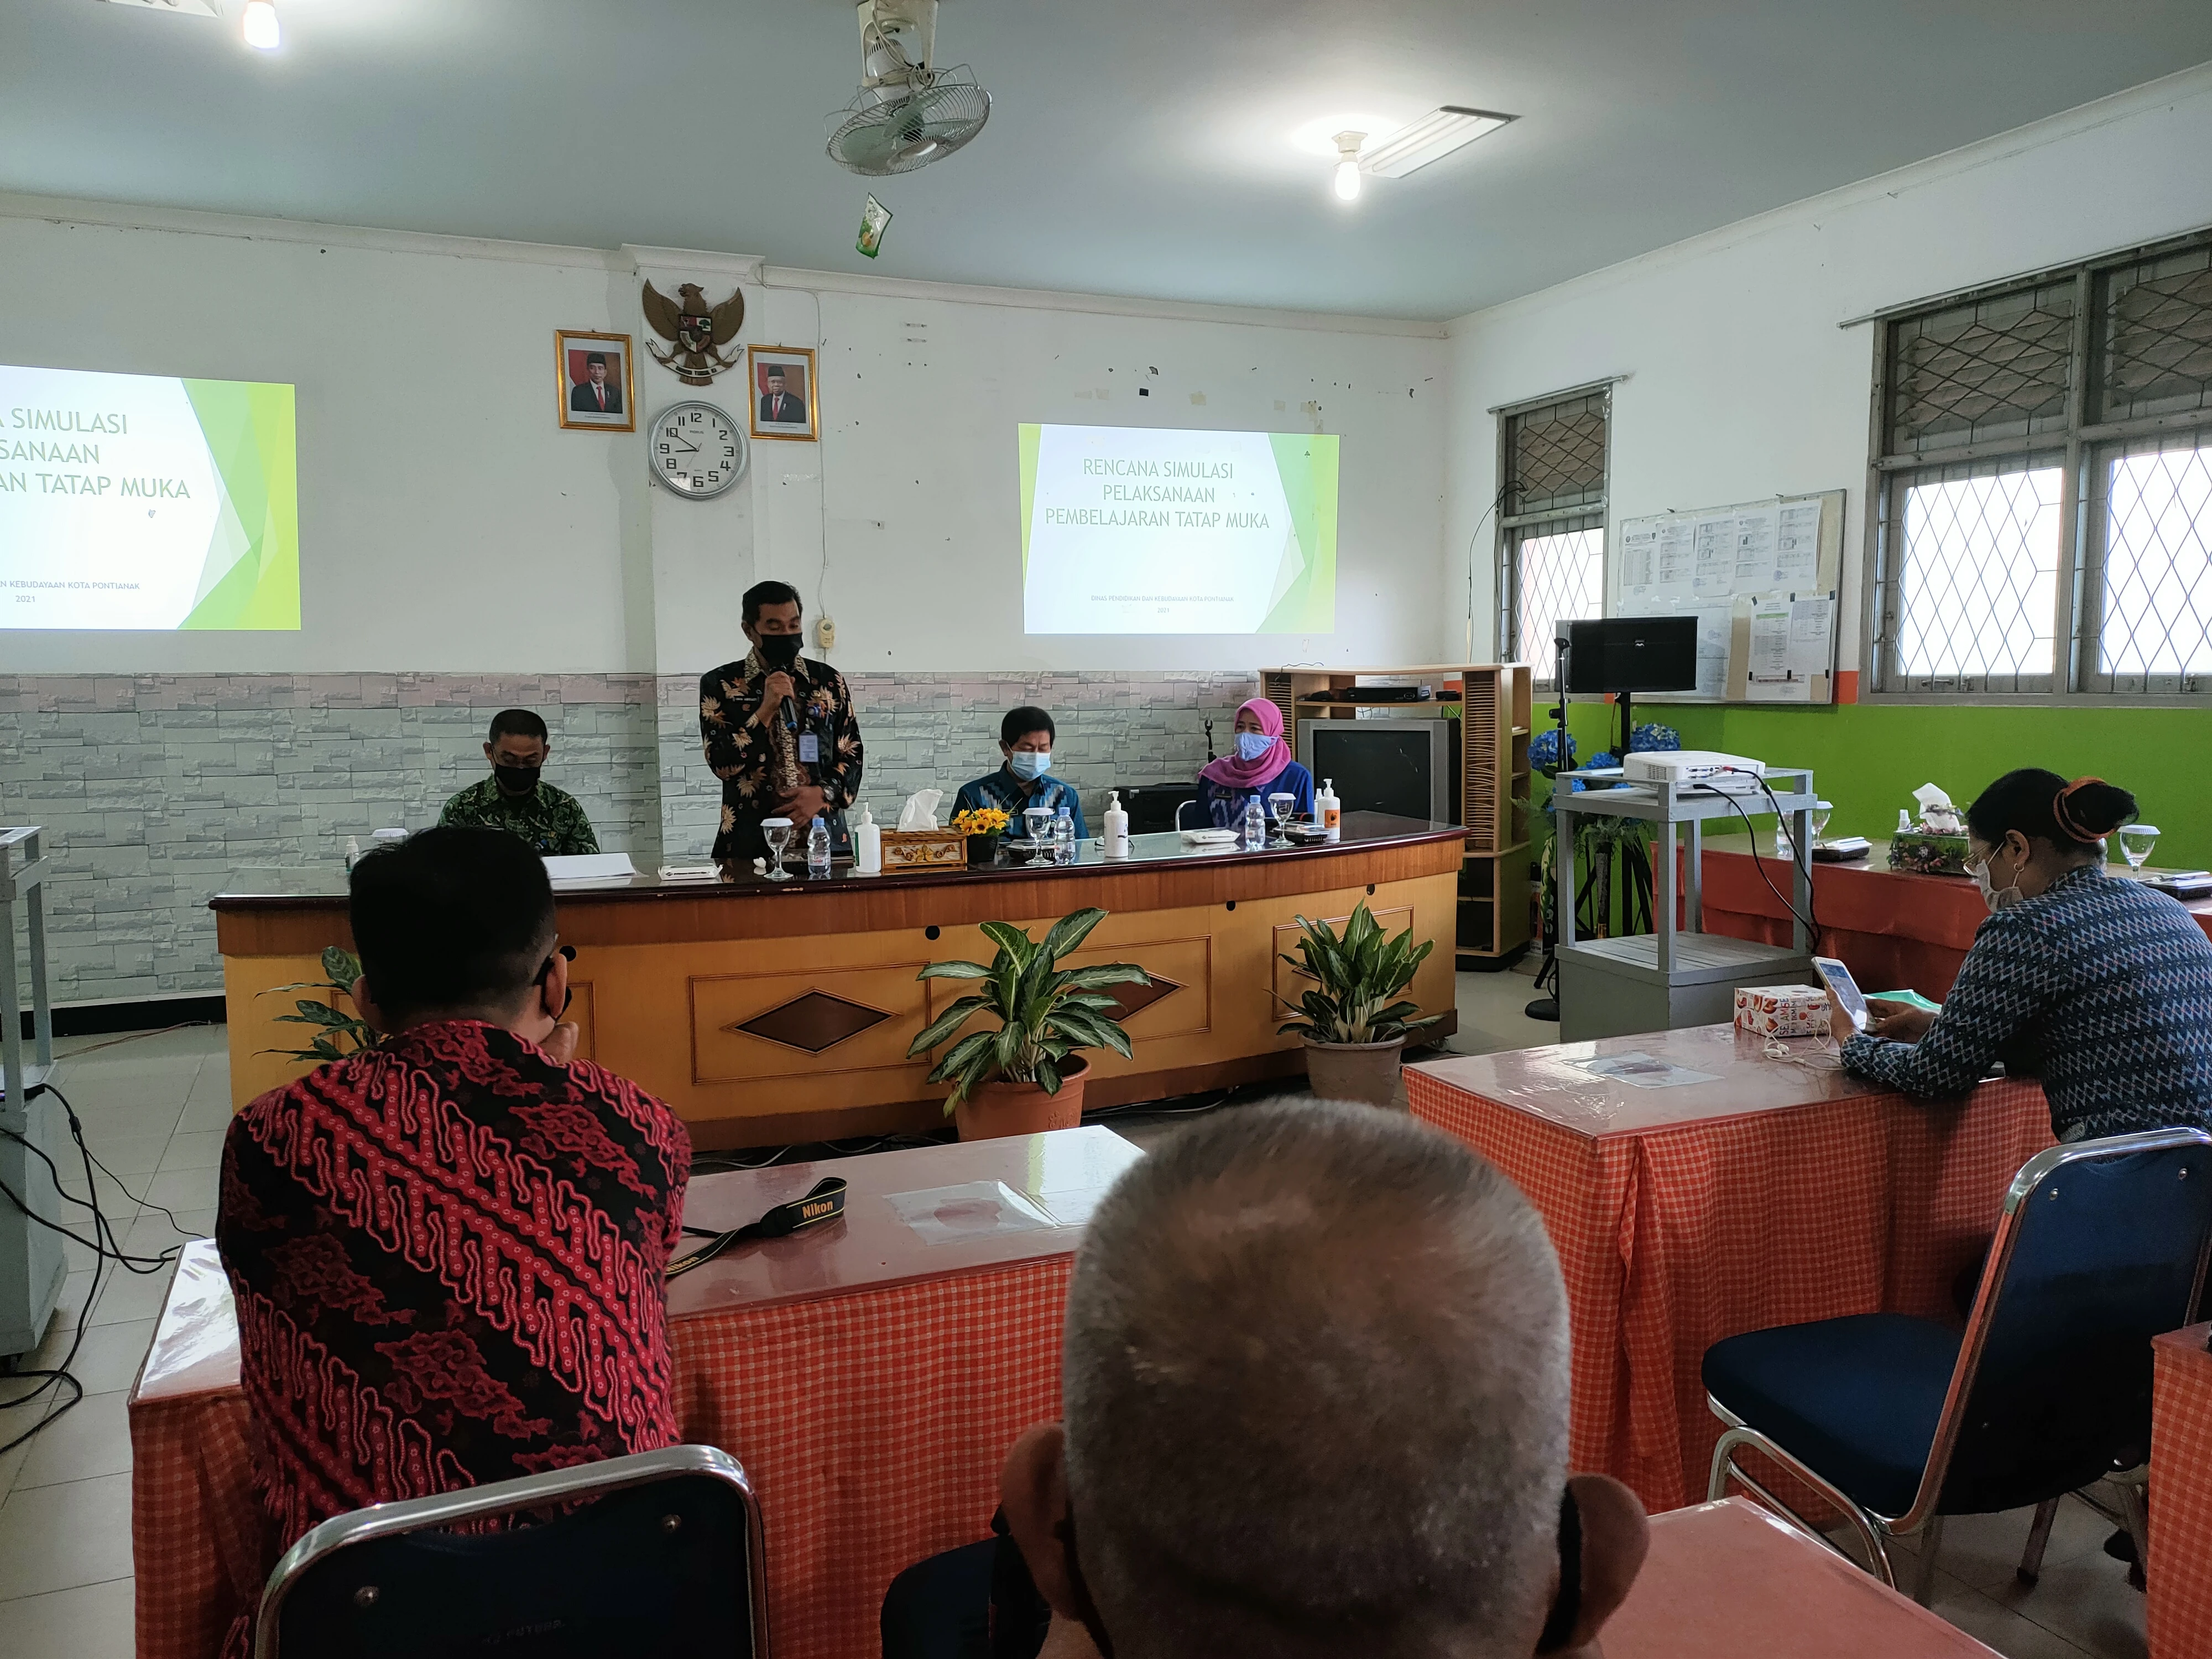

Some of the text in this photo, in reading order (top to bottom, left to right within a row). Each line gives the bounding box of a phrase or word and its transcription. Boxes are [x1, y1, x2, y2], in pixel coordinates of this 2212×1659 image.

[11, 408, 127, 434] SIMULASI
[677, 416, 685, 426] 11
[690, 412, 702, 423] 12
[712, 418, 716, 427] 1
[666, 427, 678, 437] 10
[718, 430, 728, 441] 2
[659, 443, 670, 454] 9
[723, 446, 735, 457] 3
[666, 458, 677, 469] 8
[719, 460, 732, 472] 4
[1083, 458, 1234, 479] RENCANA SIMULASI
[692, 476, 704, 488] 6
[708, 471, 719, 483] 5
[35, 473, 111, 495] TATAP
[121, 477, 191, 499] MUKA
[1103, 484, 1215, 503] PELAKSANAAN
[1045, 508, 1270, 529] PEMBELAJARAN TATAP MUKA
[9, 580, 65, 589] KEBUDAYAAN
[68, 581, 91, 589] KOTA
[92, 582, 140, 590] PONTIANAK
[802, 1201, 834, 1219] Nikon
